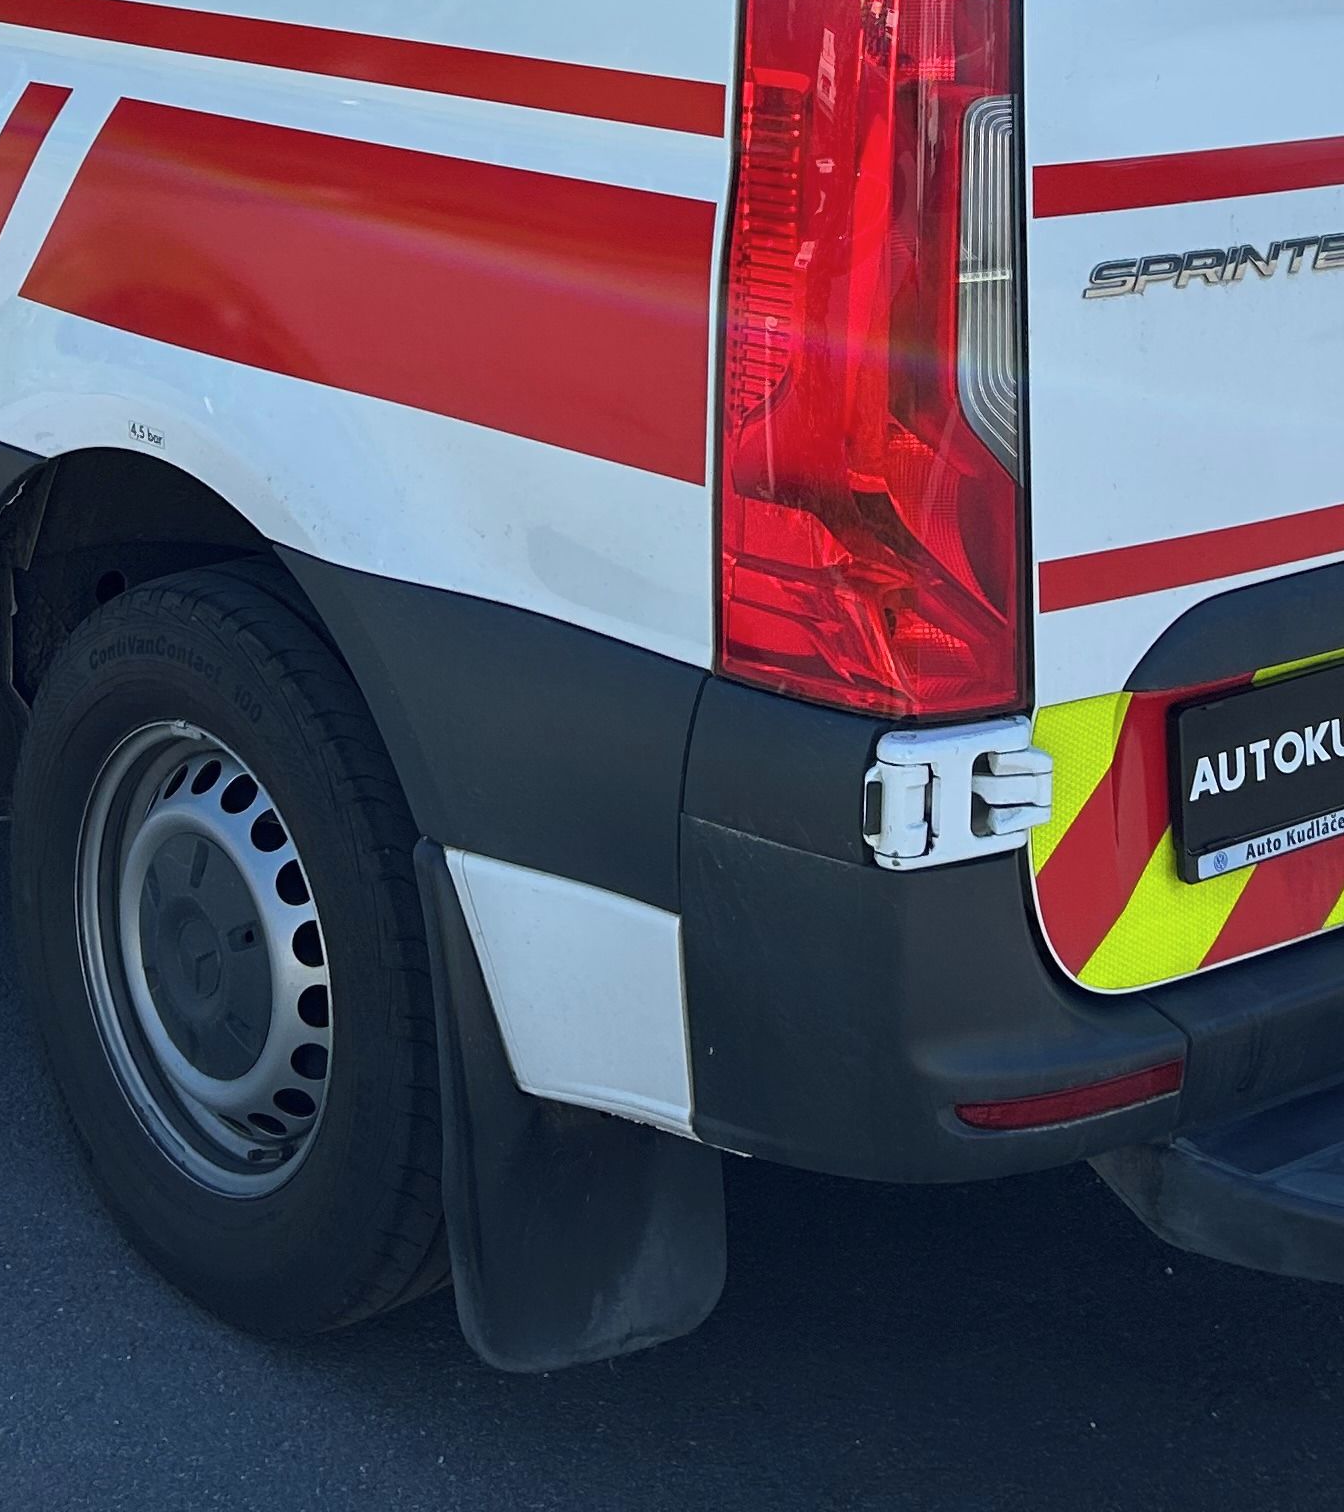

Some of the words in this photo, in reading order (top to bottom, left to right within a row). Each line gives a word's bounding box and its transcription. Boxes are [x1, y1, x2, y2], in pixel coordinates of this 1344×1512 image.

[130, 423, 145, 440] 4,5
[147, 427, 163, 445] bar
[89, 634, 223, 684] ContiVanContact
[1245, 838, 1282, 861] Auto
